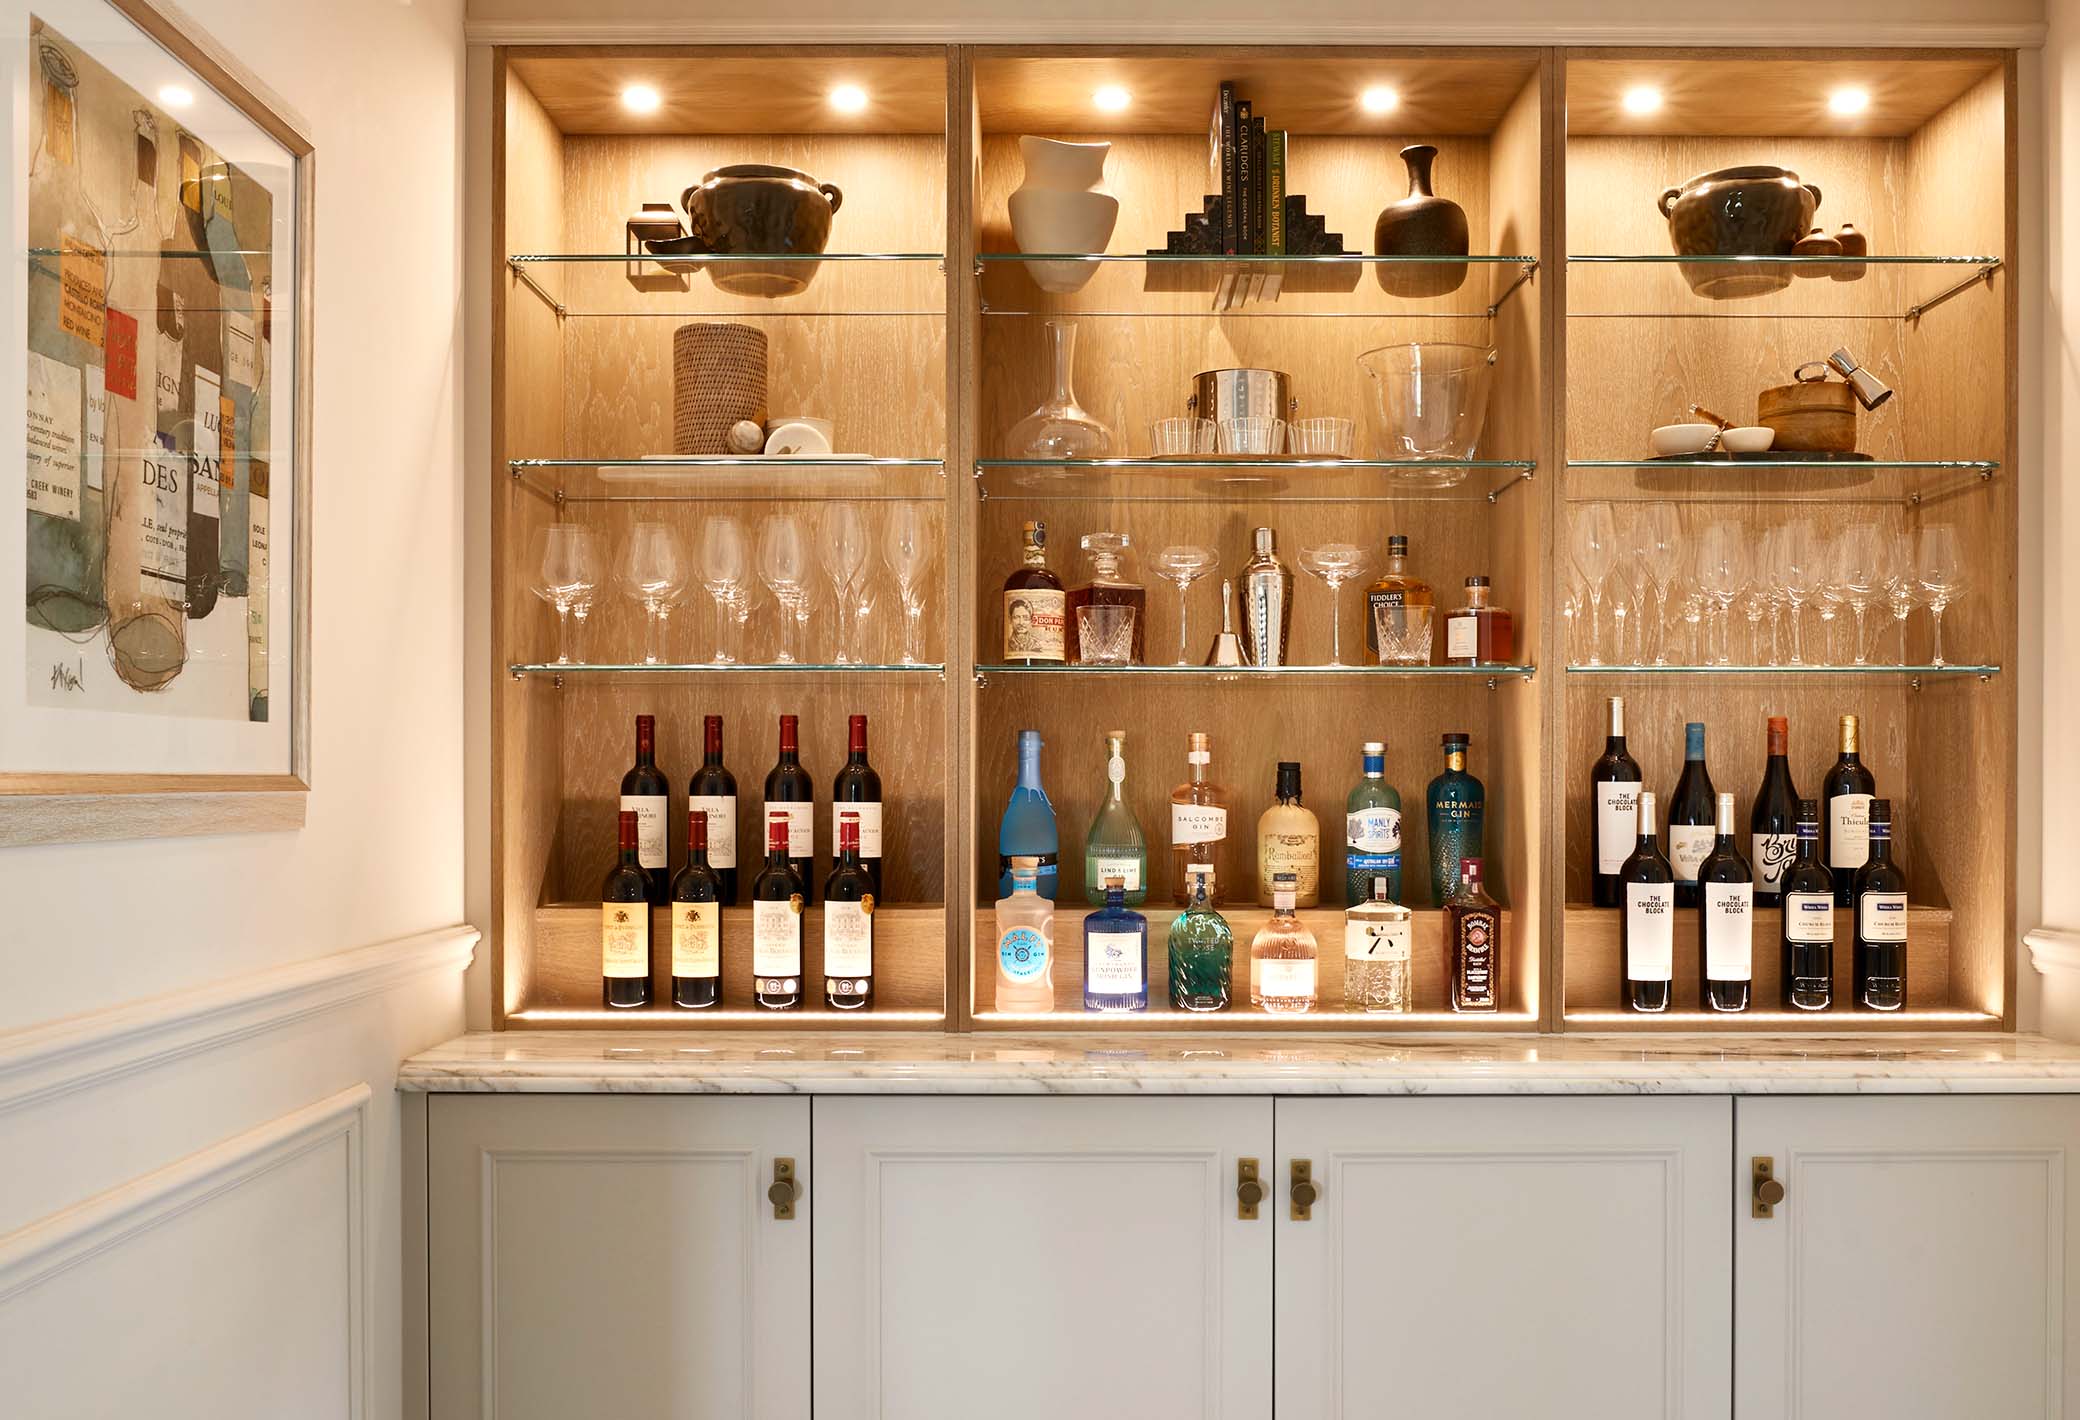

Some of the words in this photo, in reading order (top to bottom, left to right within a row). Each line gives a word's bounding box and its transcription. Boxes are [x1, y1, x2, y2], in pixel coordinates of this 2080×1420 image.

[1271, 175, 1280, 209] DRUNKEN
[1271, 211, 1280, 247] BOTANIST
[142, 458, 178, 494] DES
[30, 478, 49, 493] CREEK
[52, 484, 75, 500] WINERY
[1370, 593, 1403, 602] FIDDLER'S
[1038, 616, 1053, 625] DON
[1435, 801, 1482, 809] MERMAID
[1450, 810, 1471, 818] GIN
[1367, 817, 1391, 828] MANLY
